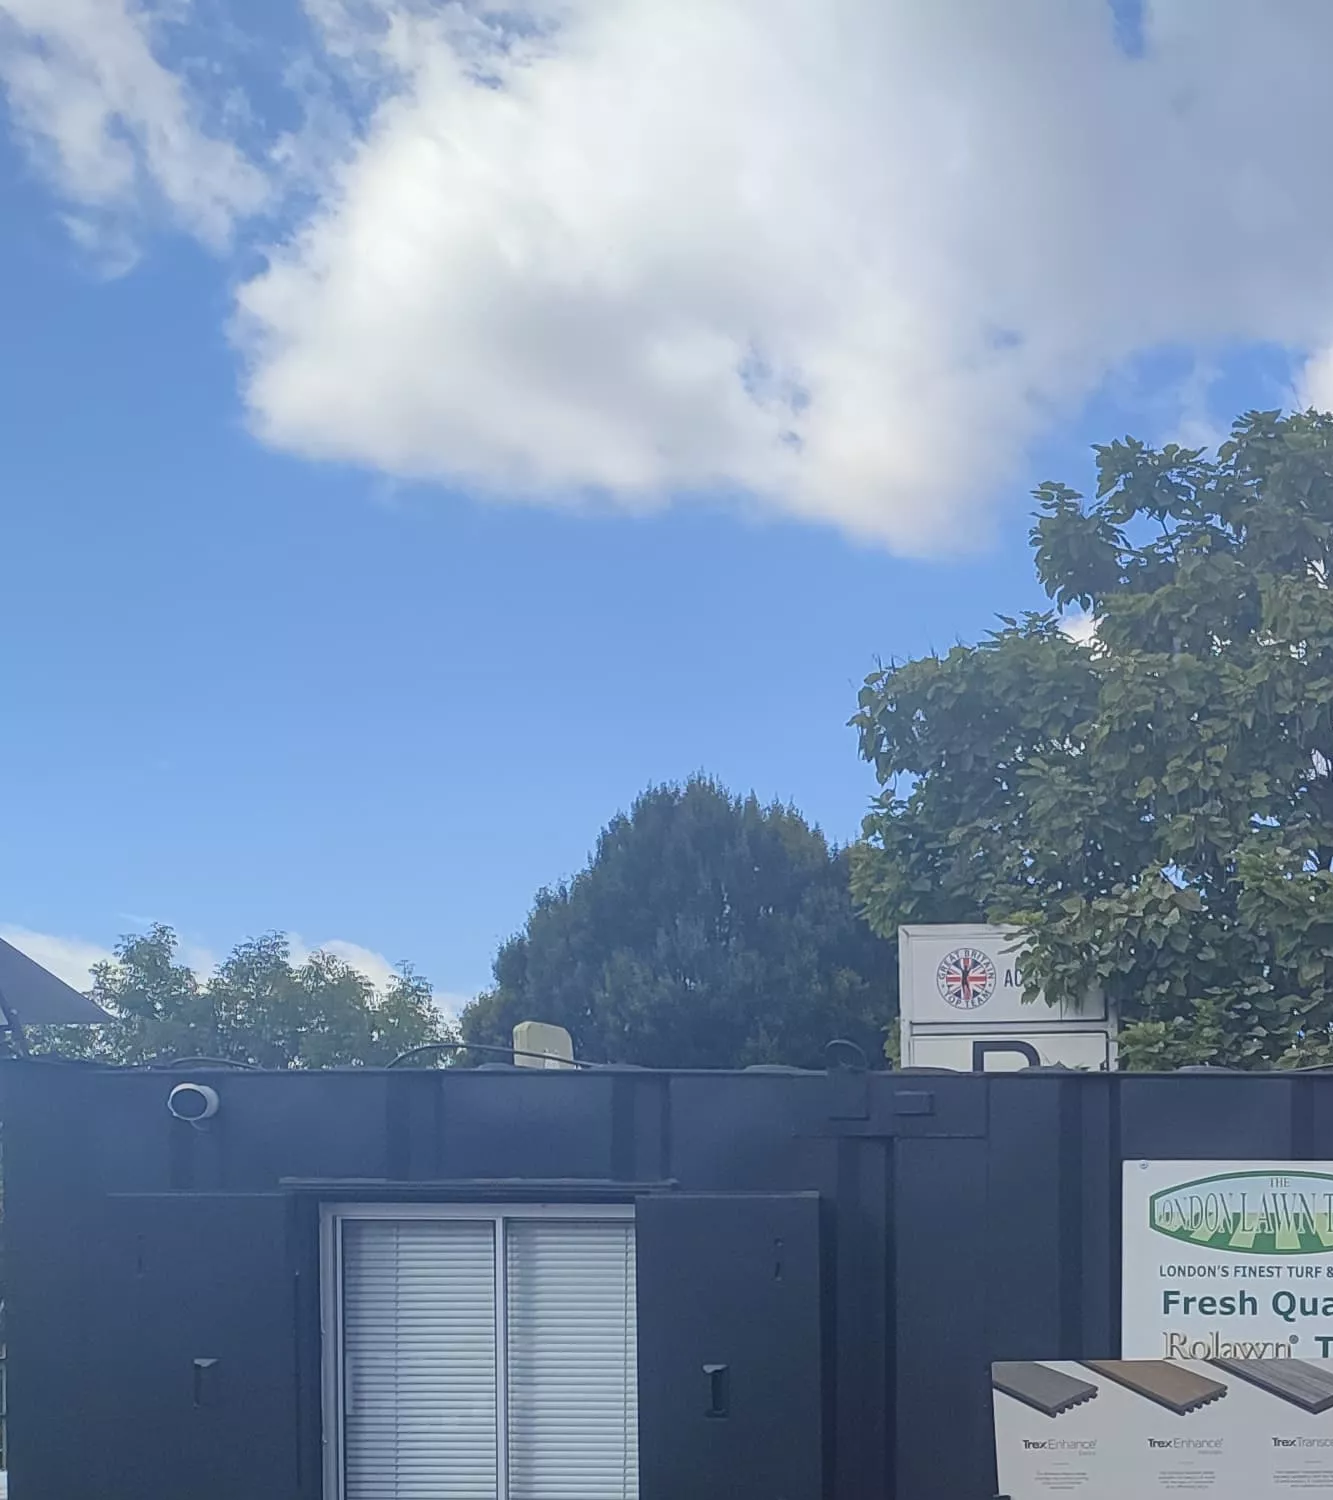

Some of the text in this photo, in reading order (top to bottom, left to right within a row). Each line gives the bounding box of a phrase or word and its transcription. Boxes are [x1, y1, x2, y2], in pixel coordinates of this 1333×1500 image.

[965, 949, 994, 979] BRITAIN
[945, 990, 992, 1008] TOP TEAM
[1270, 1178, 1290, 1188] THE
[1156, 1192, 1234, 1234] ONDON
[1240, 1192, 1316, 1235] LAWN
[1159, 1265, 1229, 1278] LONDON'S
[1233, 1265, 1283, 1278] FINEST
[1287, 1265, 1322, 1279] TURF
[1162, 1290, 1257, 1315] Fresh
